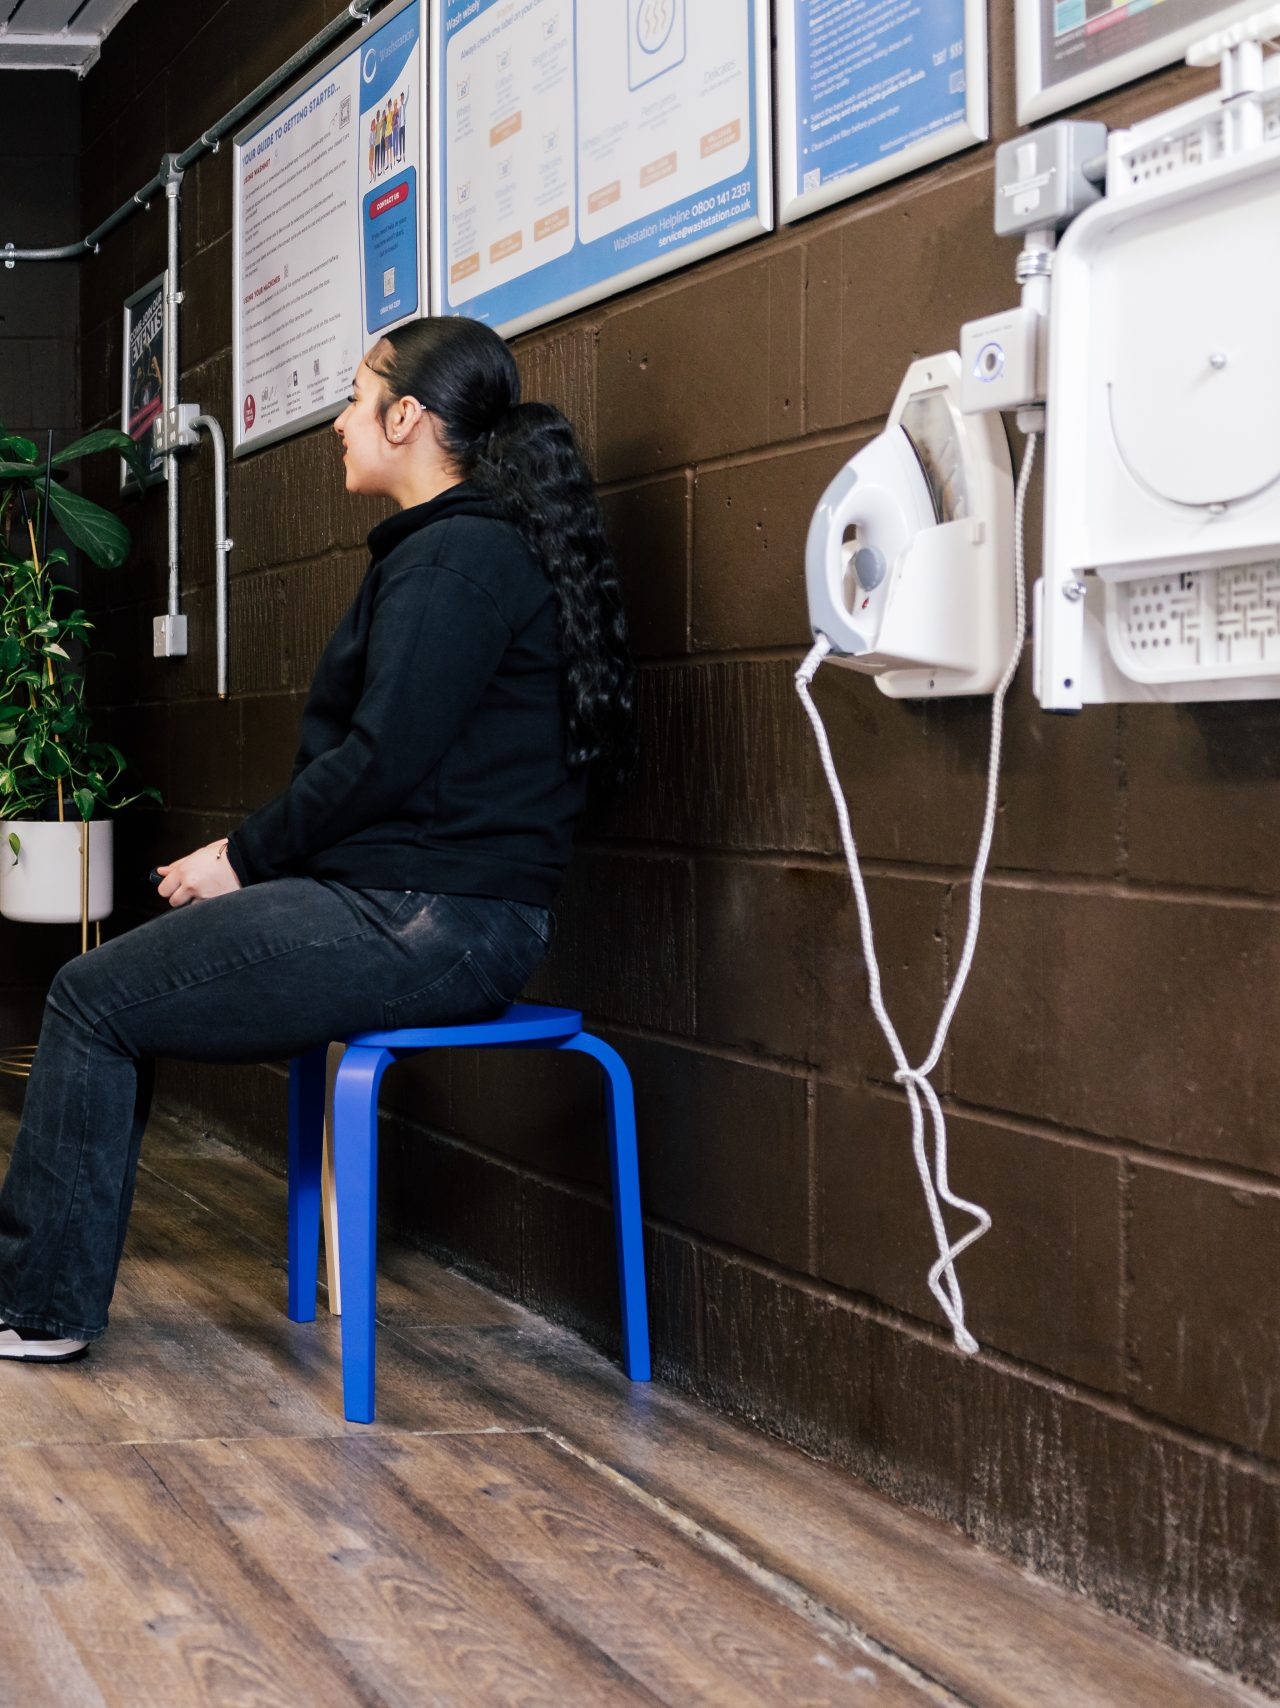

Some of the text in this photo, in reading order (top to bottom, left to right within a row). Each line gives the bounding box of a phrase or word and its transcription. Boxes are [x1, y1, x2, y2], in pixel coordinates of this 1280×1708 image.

[447, 11, 462, 32] Wash
[460, 43, 477, 60] Always
[242, 147, 256, 167] YOUR
[257, 134, 274, 156] GUIDE
[275, 127, 283, 141] TO
[283, 106, 308, 134] GETTING
[376, 191, 400, 211] CONTACT US
[613, 181, 751, 252] Washstation Helpline 0800 141 2331
[658, 199, 751, 248] service@washstation.co.uk
[130, 291, 162, 343] COME JOIN OUR
[132, 305, 162, 366] EVENTS
